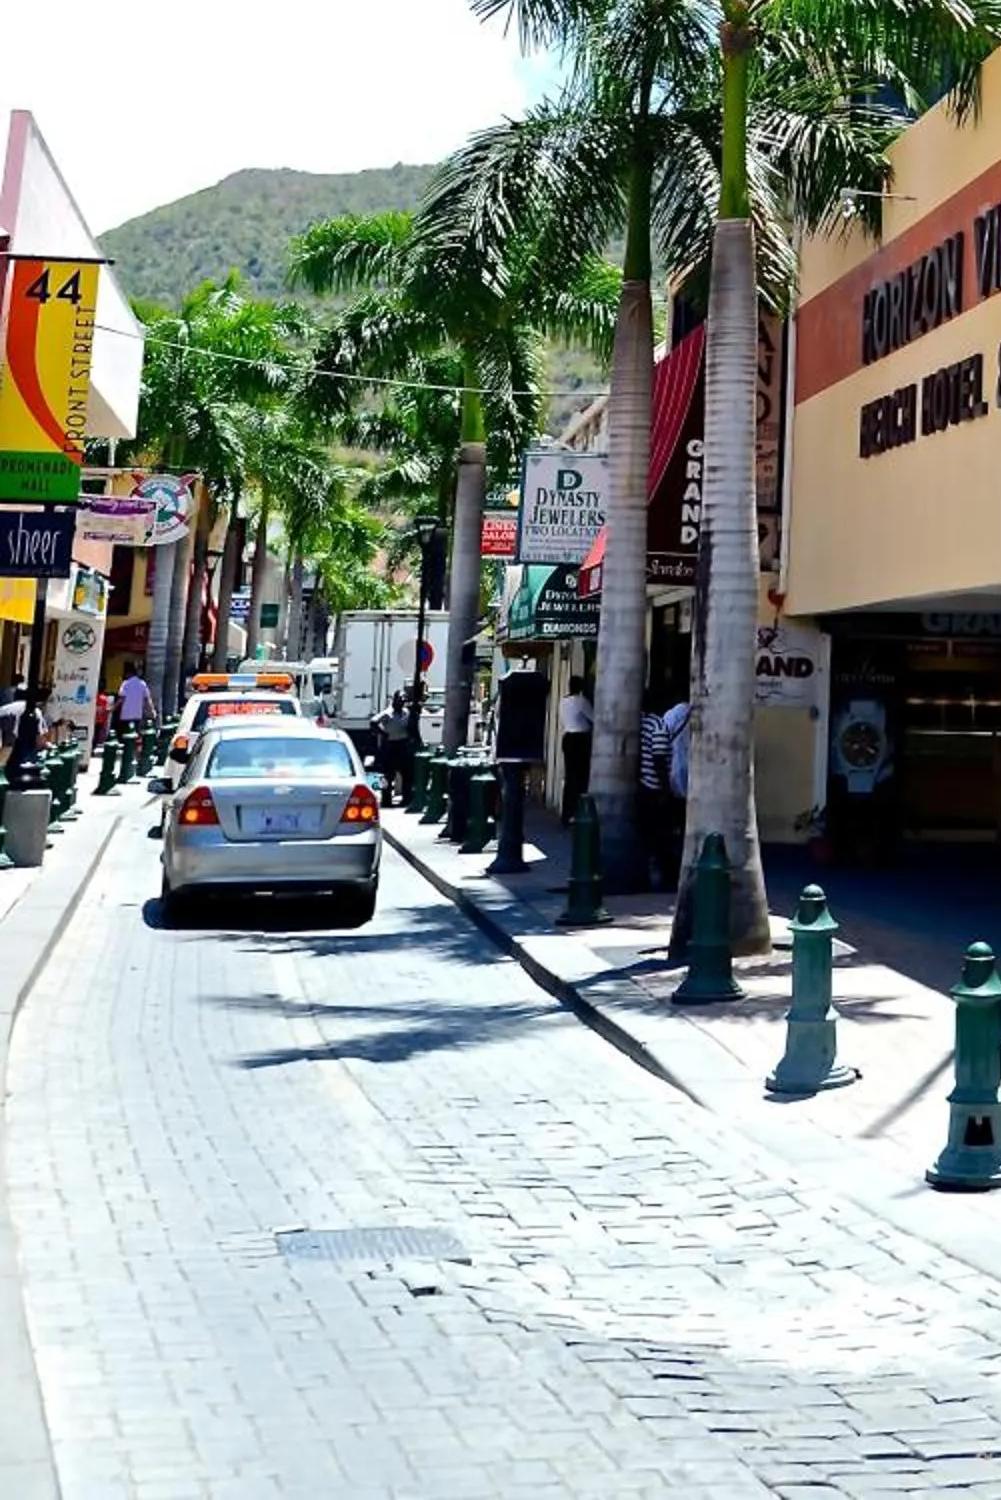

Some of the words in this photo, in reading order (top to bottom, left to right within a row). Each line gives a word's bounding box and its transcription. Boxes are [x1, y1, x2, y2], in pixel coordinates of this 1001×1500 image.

[25, 268, 83, 305] 44
[862, 231, 965, 366] HORIZON
[71, 306, 97, 379] STREET
[921, 353, 989, 436] HOTEL
[64, 386, 91, 454] FRONT
[529, 505, 606, 527] JEWELERS
[536, 487, 601, 507] DYNASTY
[8, 512, 62, 566] sheer
[542, 622, 598, 634] DIAMONDS
[756, 655, 814, 678] AND
